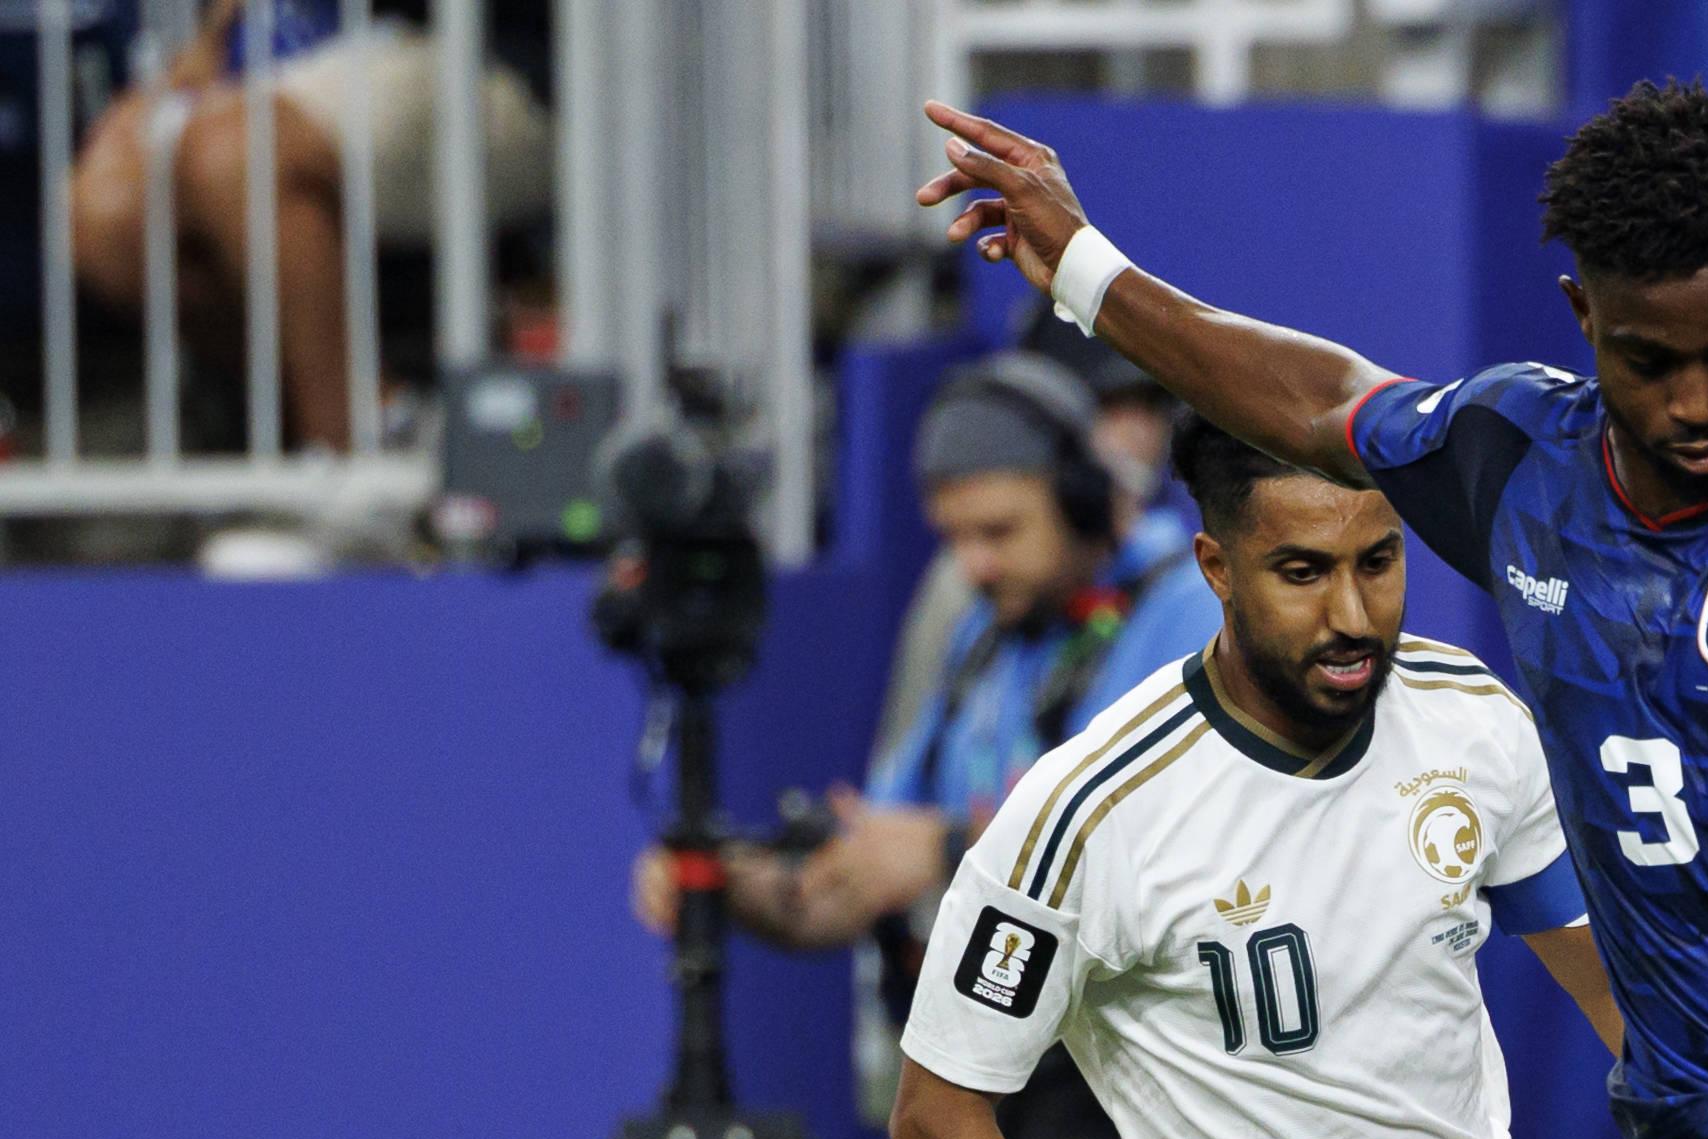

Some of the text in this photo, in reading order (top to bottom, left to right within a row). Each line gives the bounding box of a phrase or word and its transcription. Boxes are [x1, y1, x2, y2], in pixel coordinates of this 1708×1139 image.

[1507, 564, 1569, 606] capelli
[1394, 767, 1468, 797] السعودية
[1600, 735, 1700, 866] 3
[972, 983, 1013, 1008] 2026
[1197, 923, 1321, 1056] 10
